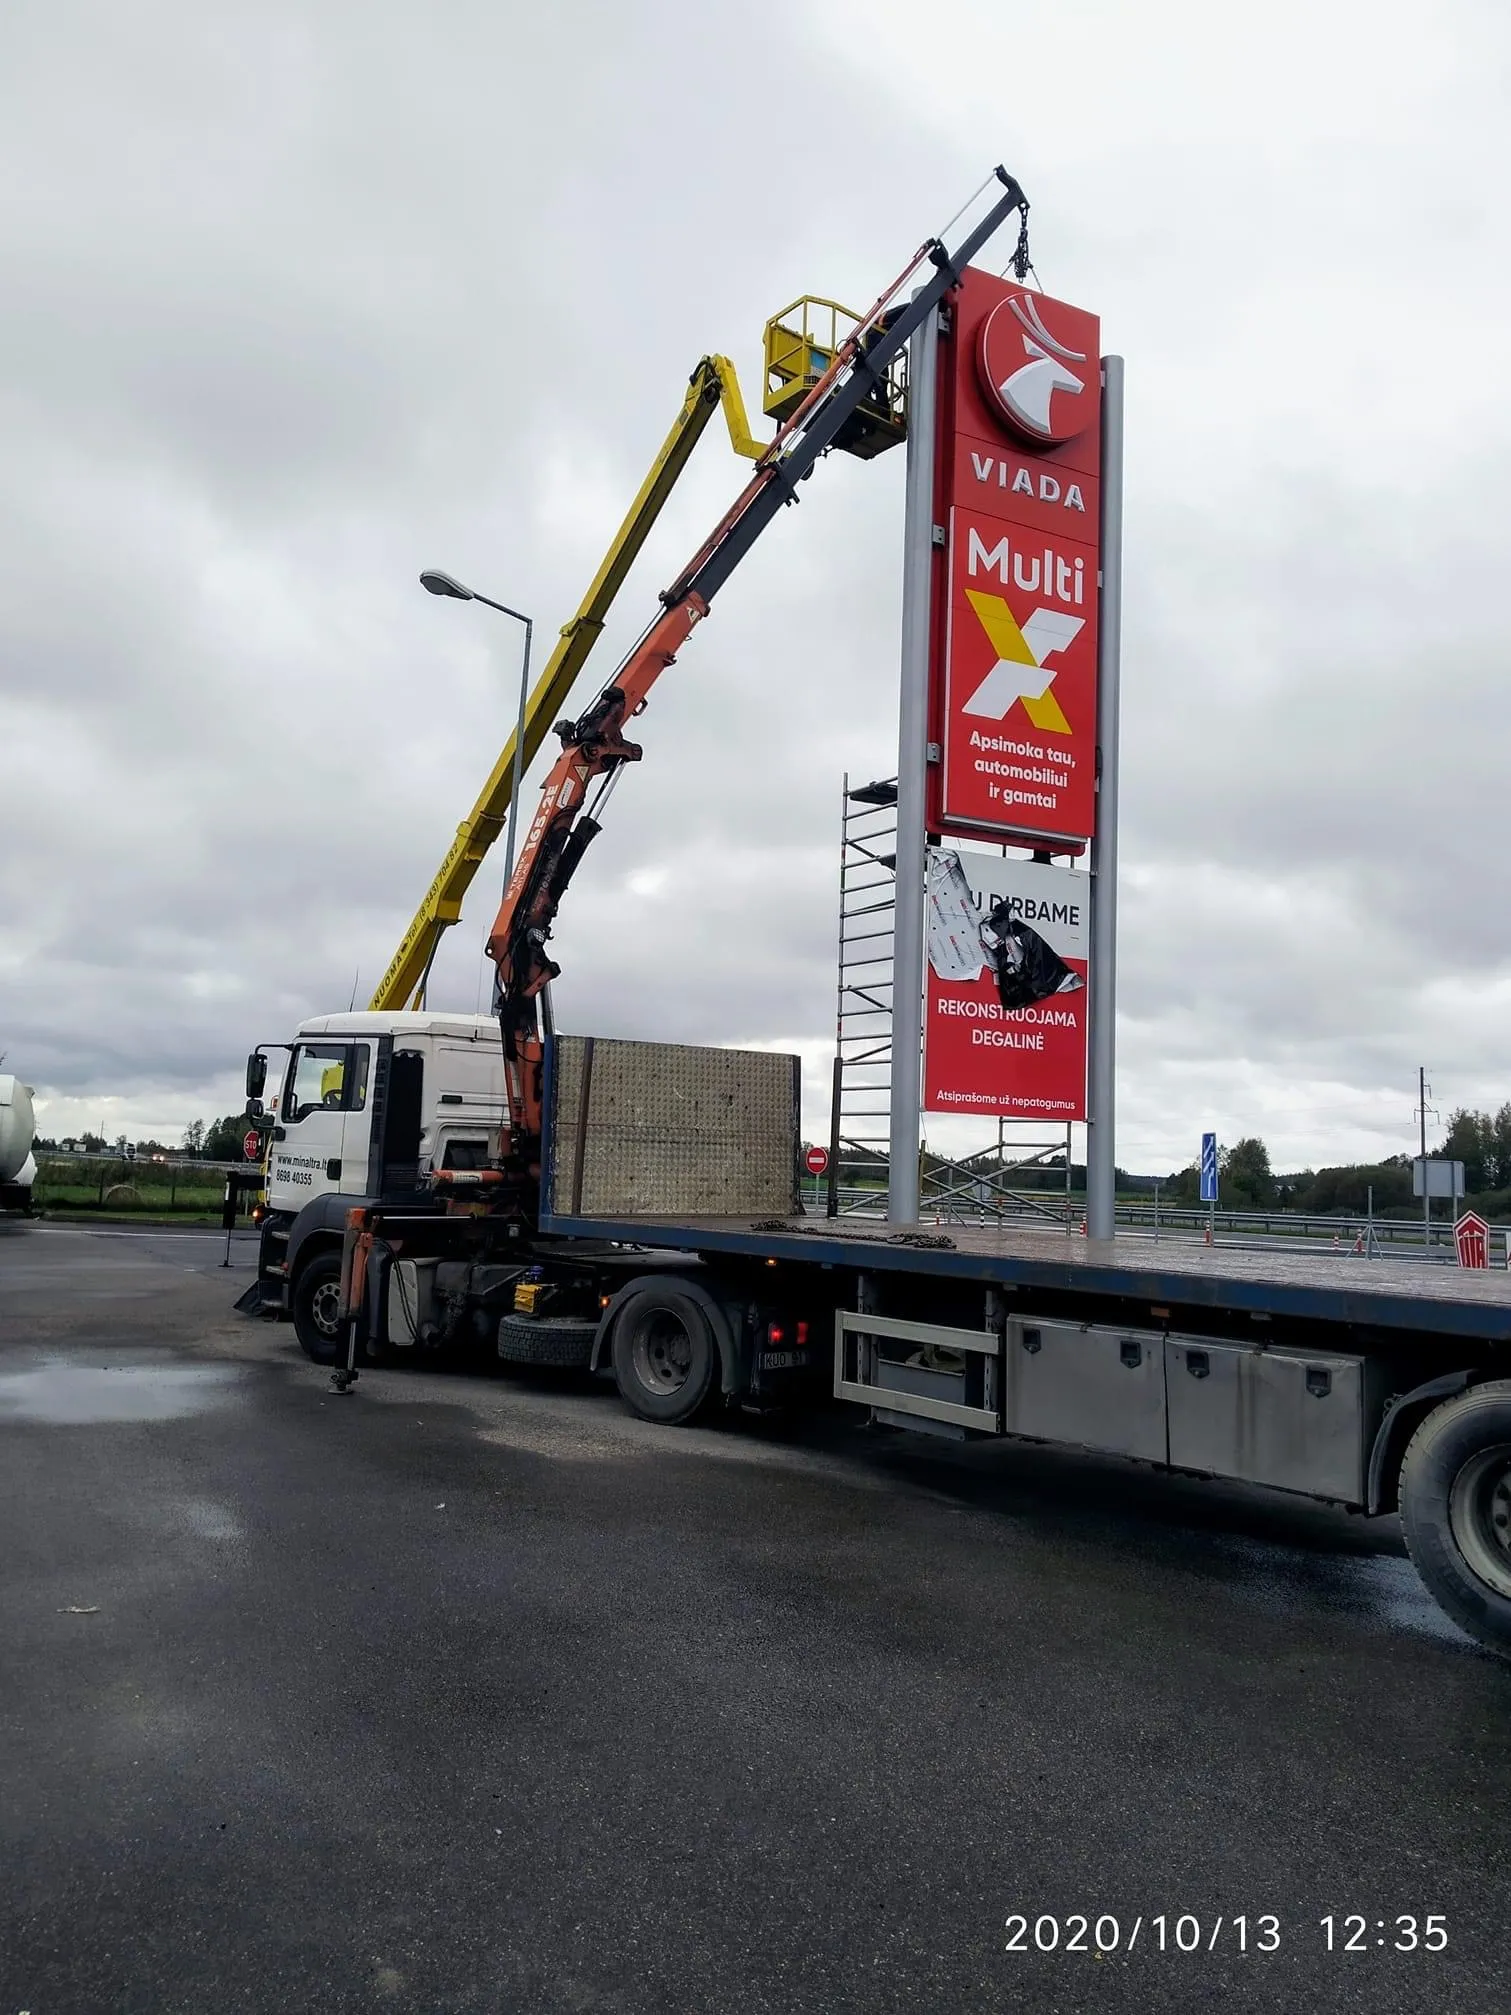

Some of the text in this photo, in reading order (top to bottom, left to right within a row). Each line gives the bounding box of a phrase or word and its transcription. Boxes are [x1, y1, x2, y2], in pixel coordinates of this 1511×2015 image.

[970, 452, 1086, 512] VIADA
[968, 527, 1084, 604] Multi
[969, 730, 1077, 769] Apsimoka tau,
[974, 759, 1069, 788] automobiliui
[988, 782, 1057, 809] ir gamtai
[525, 784, 560, 852] 165.2E
[989, 893, 1081, 926] DRBAME
[373, 955, 404, 1008] NUOMA
[937, 998, 1078, 1028] REKONSTRUOJAMA
[971, 1029, 1045, 1051] DEGALINĖ
[936, 1089, 1076, 1110] Atsiprašome už nepatogumus
[245, 1140, 258, 1150] STO
[277, 1155, 328, 1171] www.minaltra.lt
[291, 1171, 313, 1186] 40355
